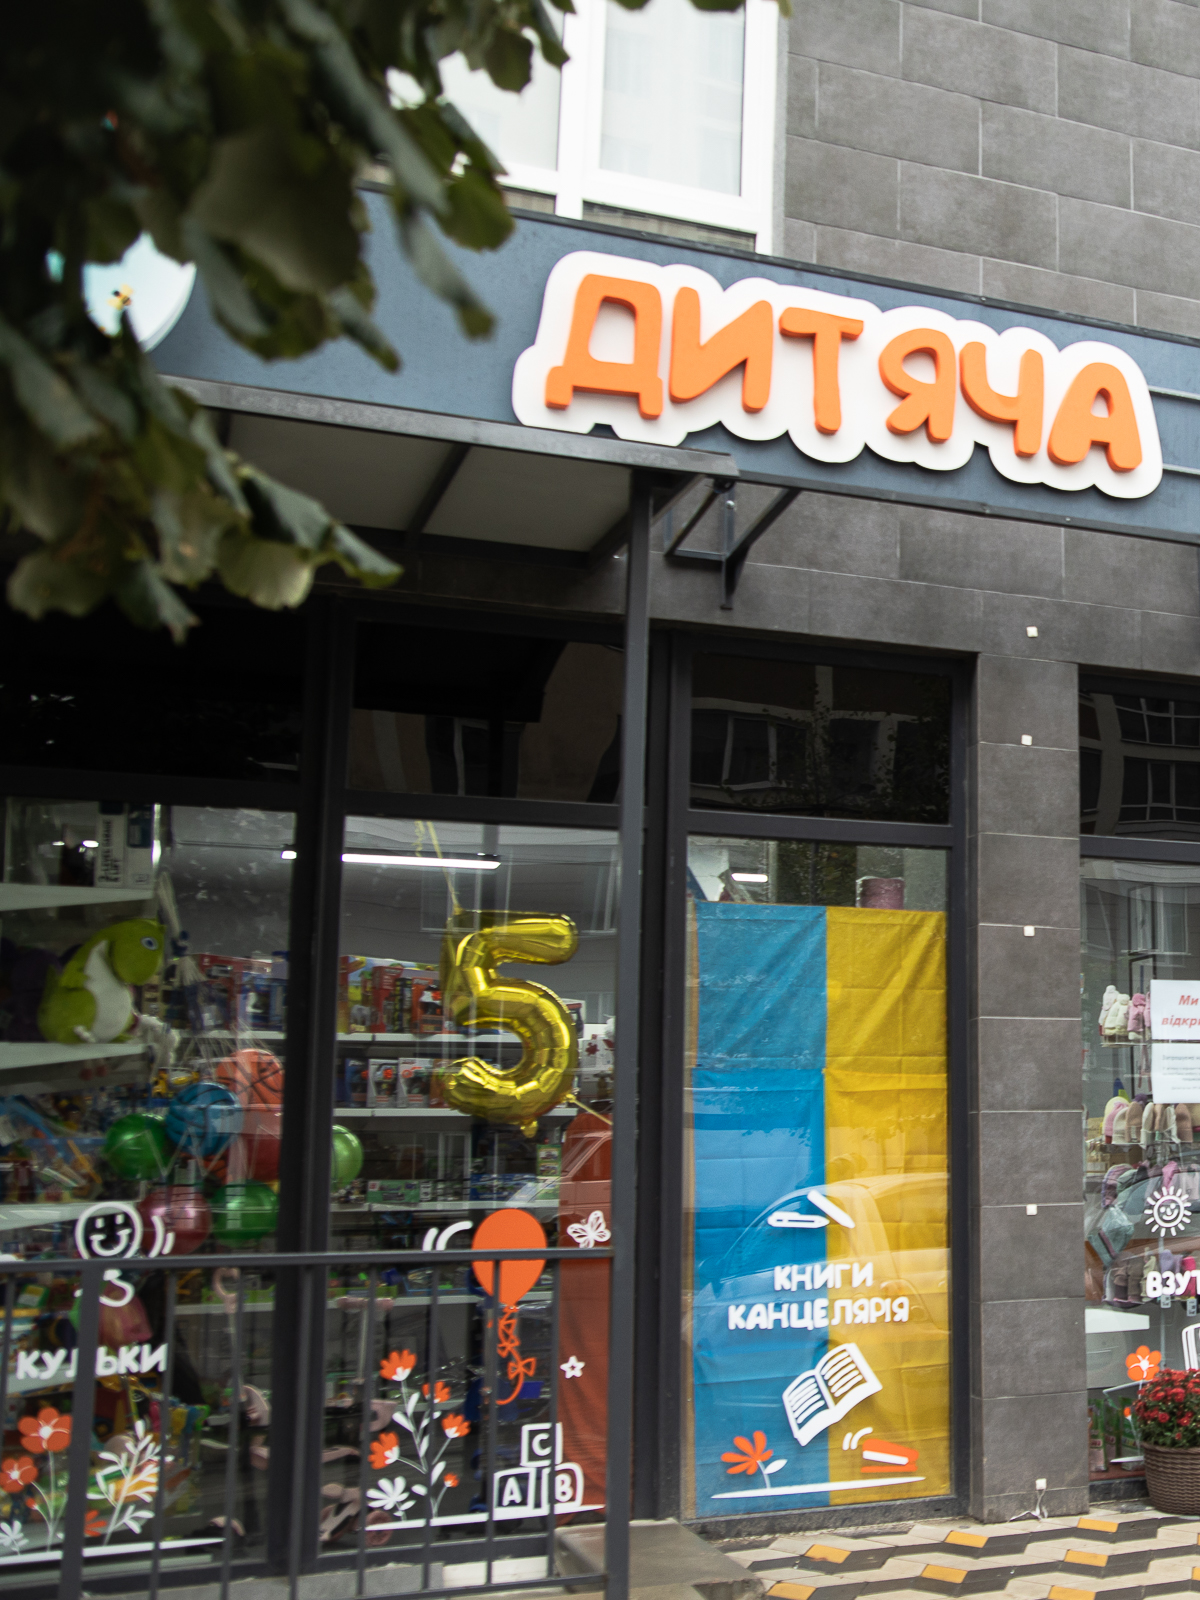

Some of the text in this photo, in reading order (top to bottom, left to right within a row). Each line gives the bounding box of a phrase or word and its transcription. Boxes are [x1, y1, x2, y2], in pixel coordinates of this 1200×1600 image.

[544, 272, 1144, 474] ДИТЯЧА
[1178, 994, 1200, 1006] Ми
[773, 1261, 874, 1292] КНИГИ
[727, 1295, 910, 1331] КАНЦЕЛЯРІЯ
